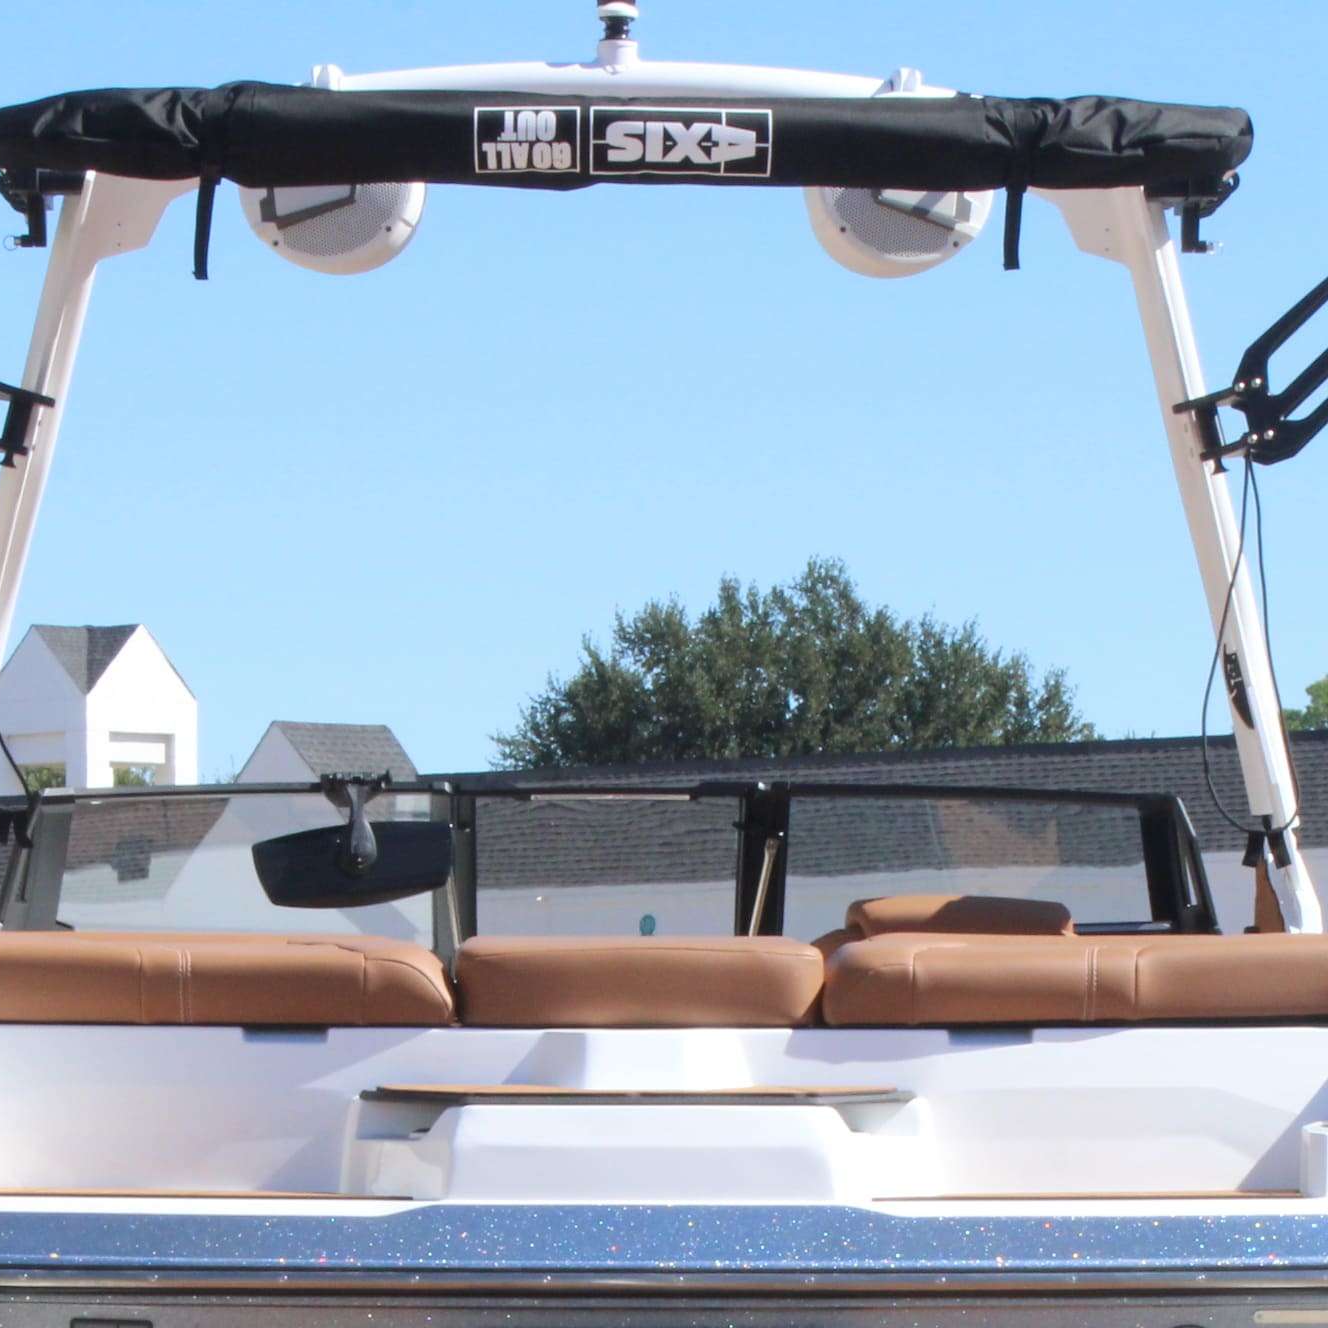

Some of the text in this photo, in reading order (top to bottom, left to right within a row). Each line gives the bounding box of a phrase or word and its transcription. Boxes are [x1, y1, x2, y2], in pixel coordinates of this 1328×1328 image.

[497, 110, 557, 142] OUT
[605, 120, 757, 164] AXIS
[481, 142, 572, 170] GO ALL
